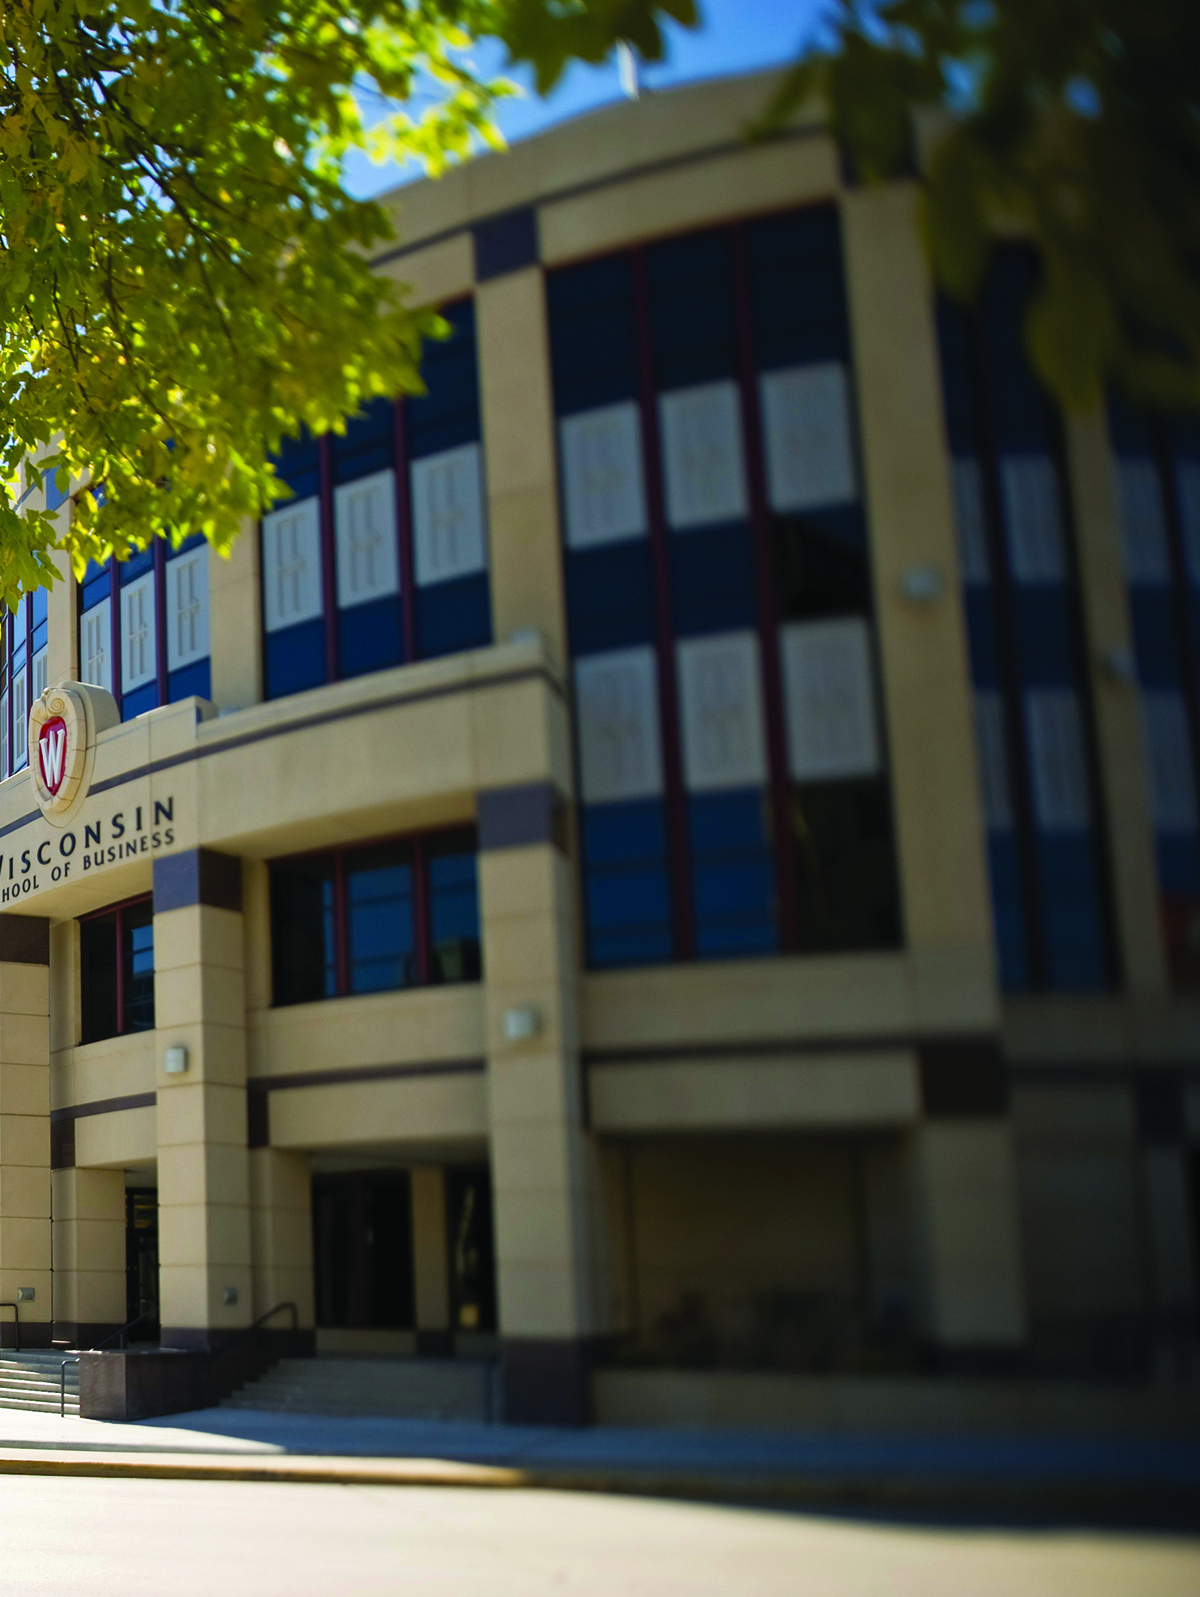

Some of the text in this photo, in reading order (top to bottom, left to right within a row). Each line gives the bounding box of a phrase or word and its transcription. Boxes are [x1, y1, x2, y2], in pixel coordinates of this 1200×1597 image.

[39, 728, 66, 788] W
[51, 861, 71, 882] OF
[83, 828, 174, 871] BUSINESS
